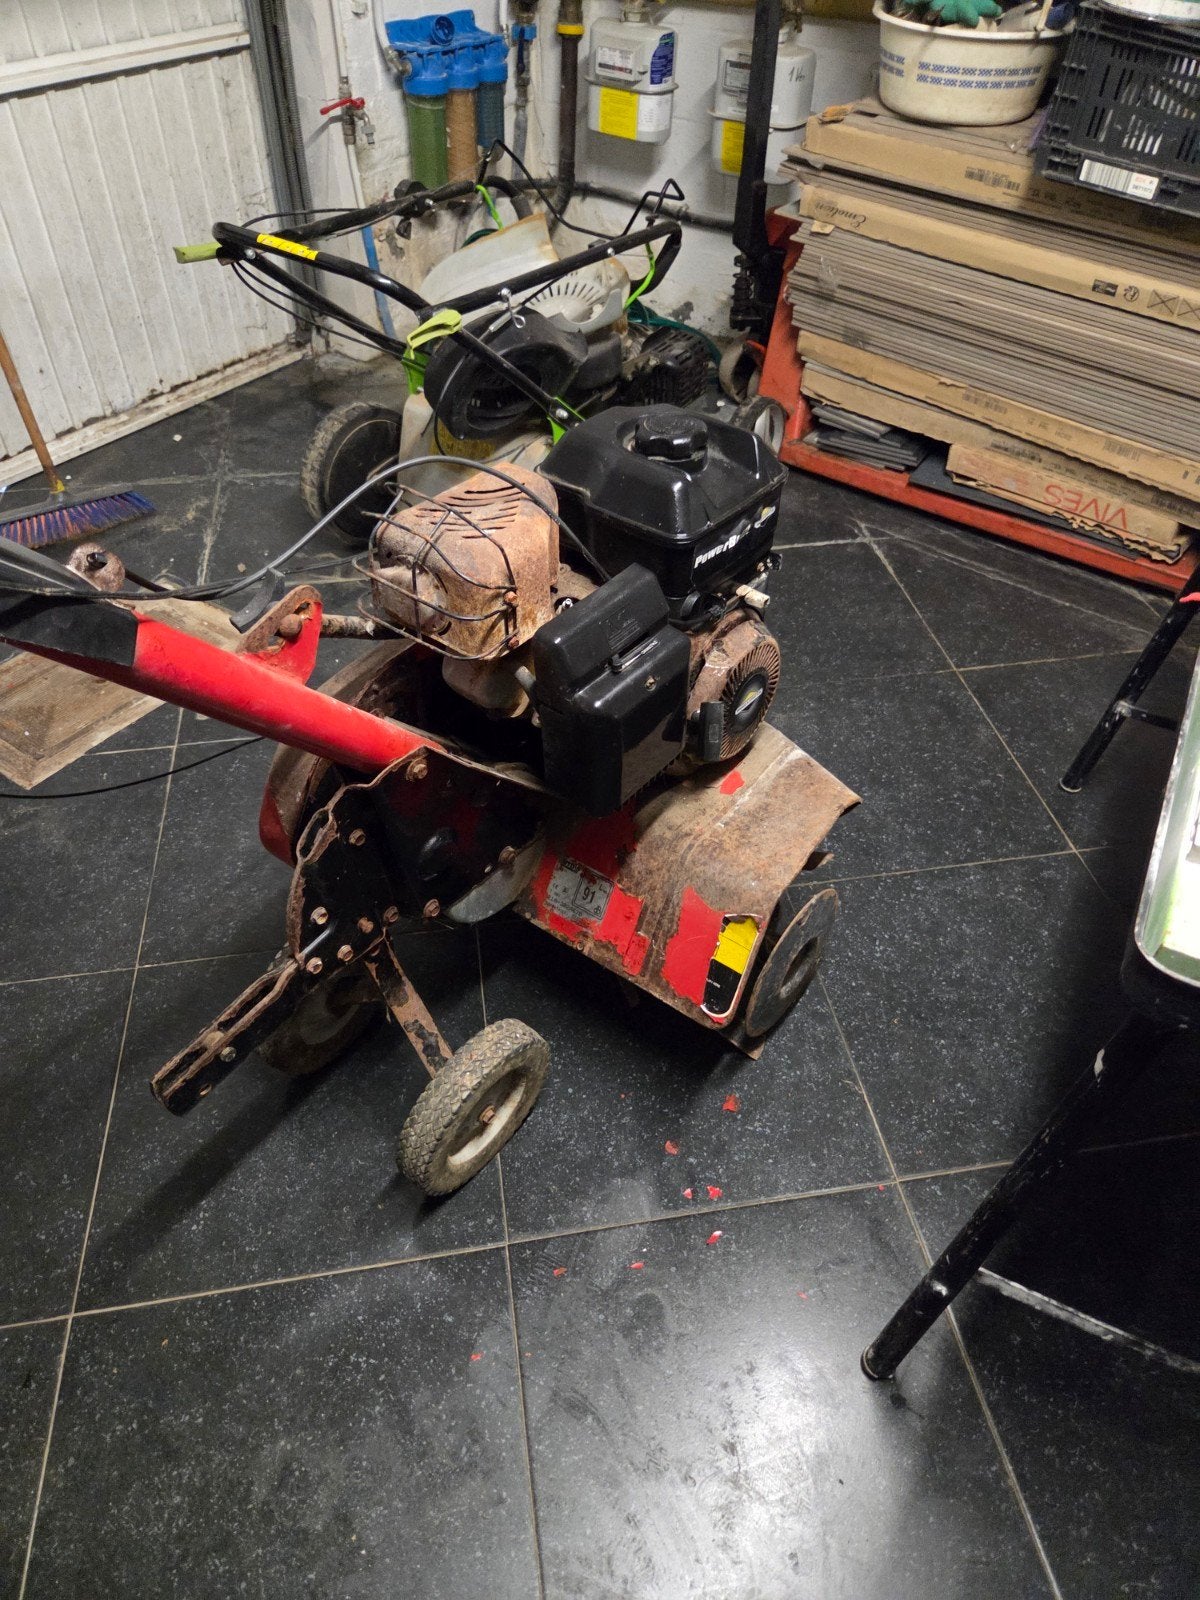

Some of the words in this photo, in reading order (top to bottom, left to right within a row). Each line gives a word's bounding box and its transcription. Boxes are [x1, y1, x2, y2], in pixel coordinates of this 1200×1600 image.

[815, 202, 867, 229] Emotion
[1043, 484, 1128, 530] VIVES
[582, 886, 596, 904] 91
